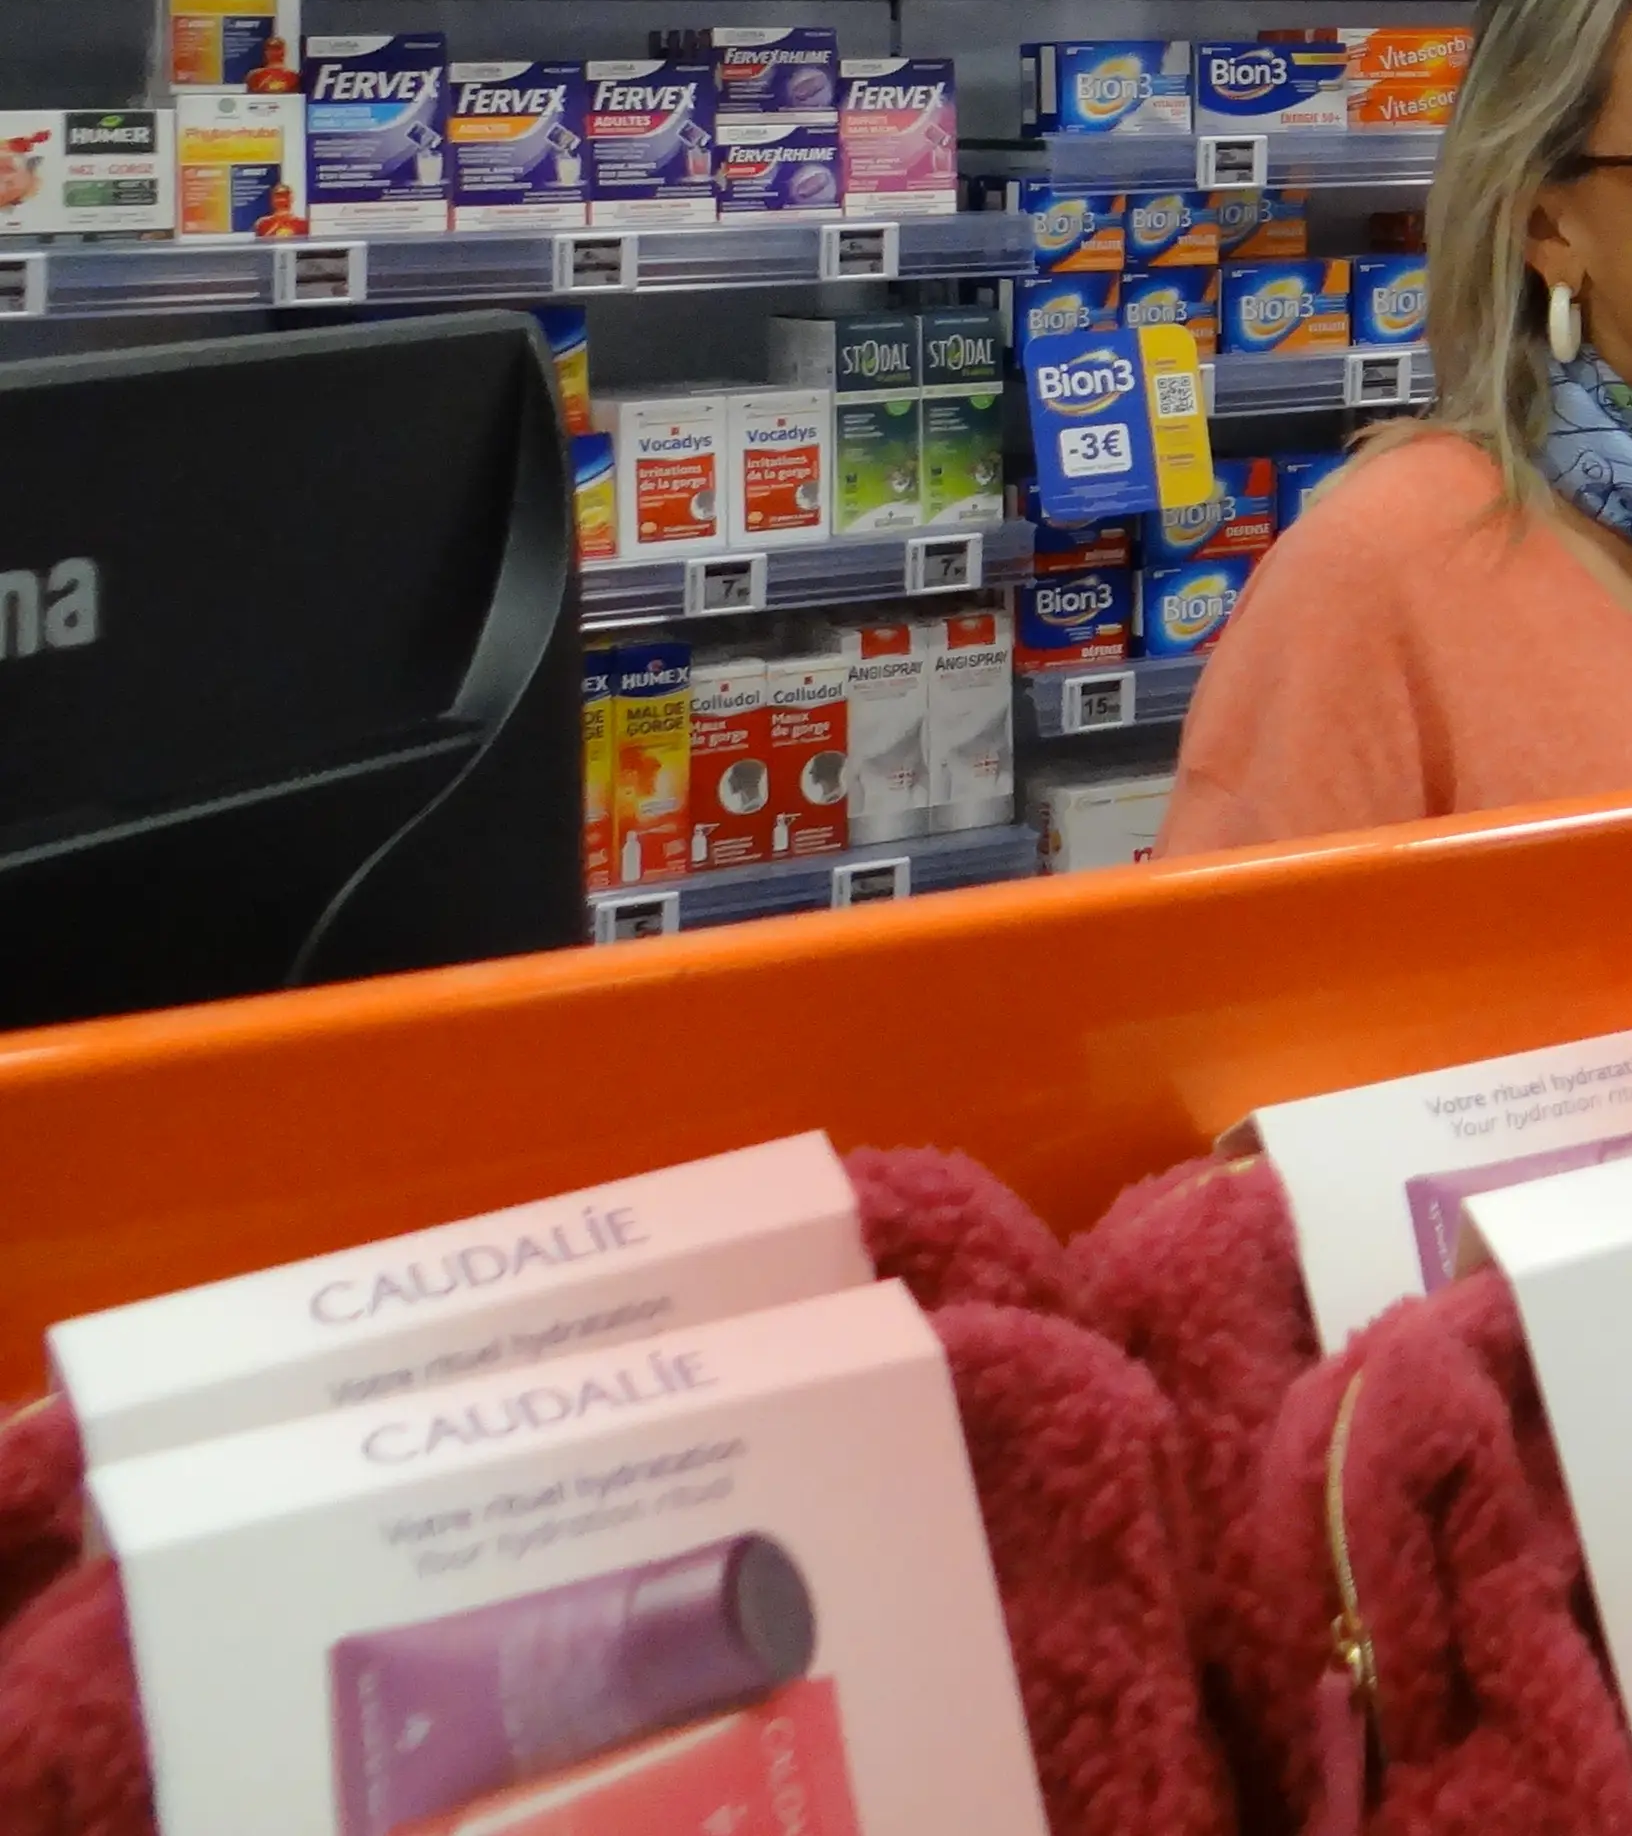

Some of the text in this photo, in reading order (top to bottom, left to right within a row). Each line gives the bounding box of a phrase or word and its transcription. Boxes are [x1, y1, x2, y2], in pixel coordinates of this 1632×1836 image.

[725, 48, 831, 65] FERVEX RHUME
[1380, 38, 1467, 69] Vitascorb
[313, 63, 442, 101] FERVEX
[1210, 57, 1287, 86] Bion3
[457, 82, 566, 115] FERVEX
[594, 80, 697, 111] FERVEX
[850, 81, 945, 110] FERVEX
[1076, 74, 1152, 100] Bion3
[71, 127, 150, 144] HUMER
[728, 146, 835, 164] FERVEX RHUME
[1133, 207, 1192, 231] Bion3
[1240, 292, 1313, 321] Bion3
[1037, 359, 1135, 400] Bion3
[639, 432, 713, 453] Vocadys
[746, 426, 817, 446] Vocadys
[1069, 429, 1122, 460] -3€
[639, 464, 703, 478] Irritations
[747, 455, 808, 470] Irritations
[779, 465, 811, 482] gorge
[674, 476, 706, 492] gorge
[1036, 583, 1113, 614] Bion3
[1164, 590, 1238, 622] Bion3
[936, 650, 1008, 672] ANGISPRAY
[622, 664, 690, 690] HUMEX
[773, 683, 843, 705] Colludol
[626, 701, 685, 721] MAL DE
[627, 717, 685, 737] GORGE
[791, 720, 830, 739] gorge
[1425, 1086, 1487, 1118] Votre
[1493, 1074, 1548, 1107] rituel
[1449, 1109, 1499, 1139] Your
[1504, 1092, 1601, 1131] hydration
